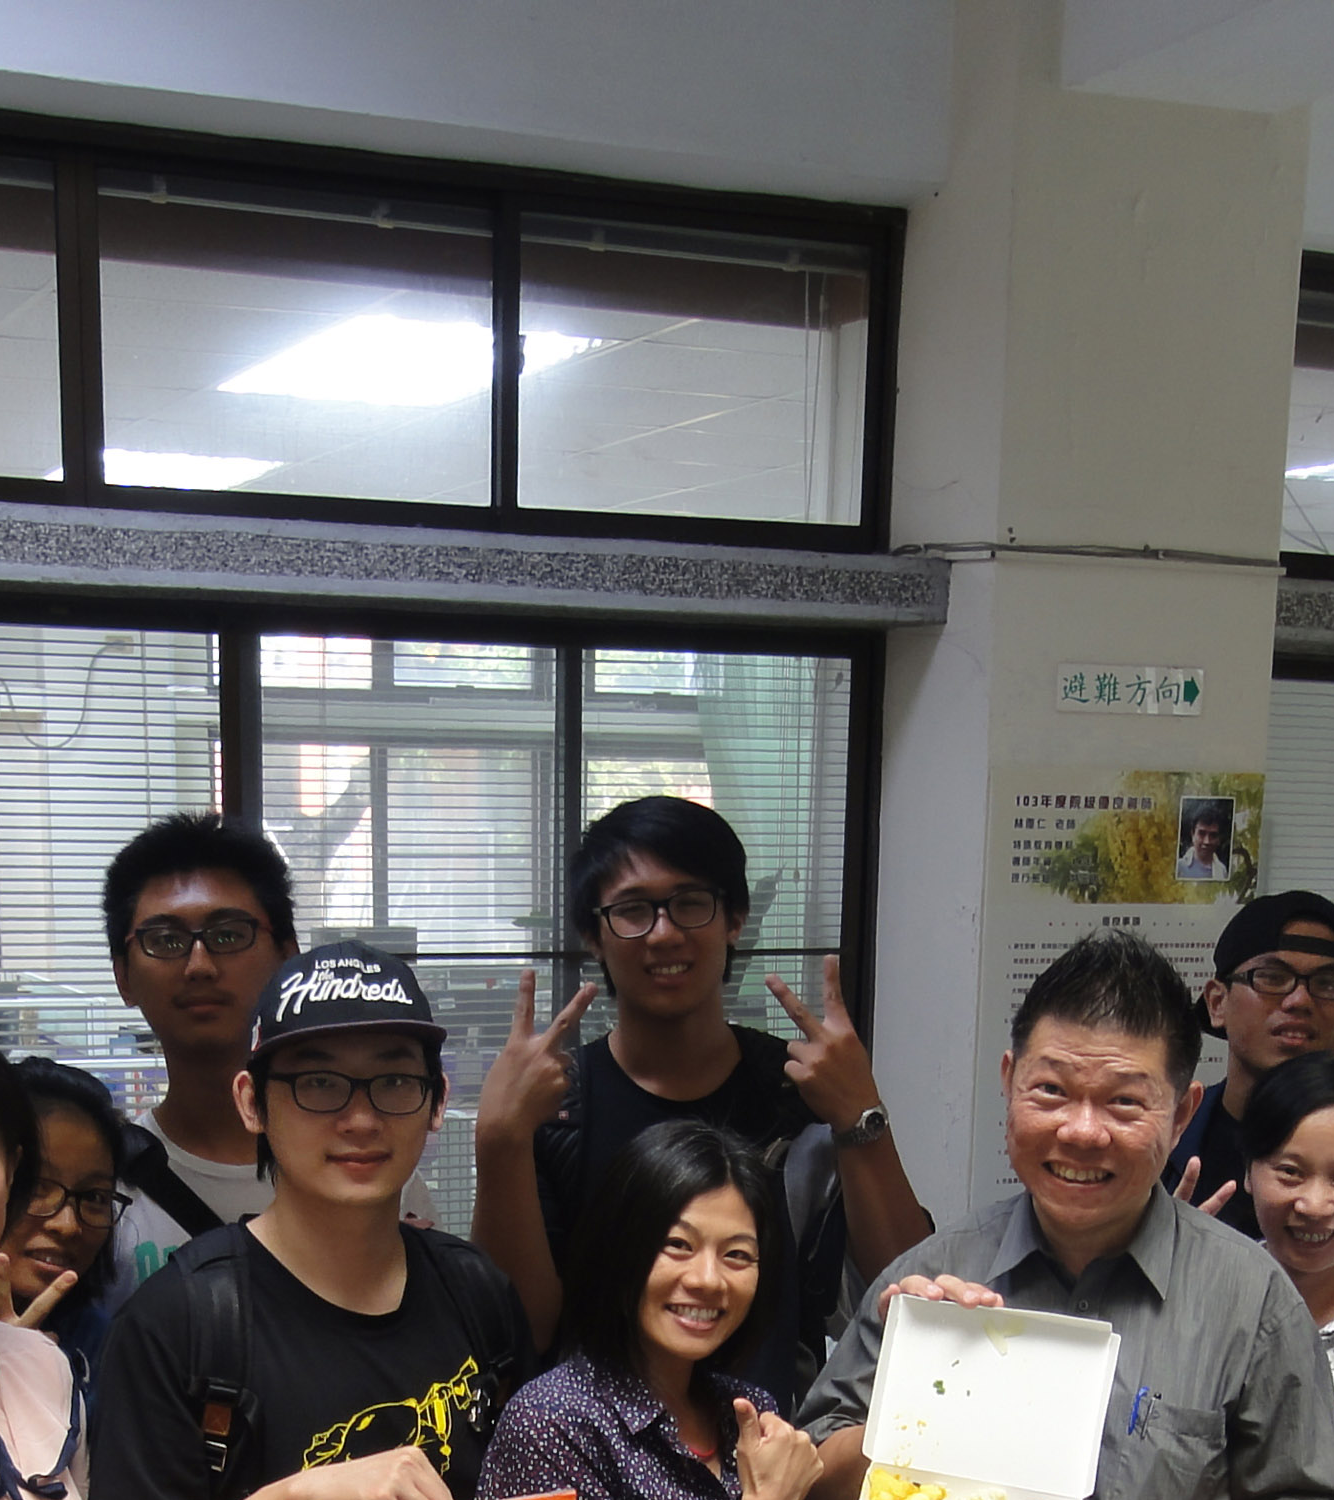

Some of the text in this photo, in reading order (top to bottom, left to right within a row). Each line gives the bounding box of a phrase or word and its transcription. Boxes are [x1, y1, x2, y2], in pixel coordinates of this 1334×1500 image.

[1061, 671, 1182, 706] 避難方向
[315, 958, 381, 973] LOS ANGLES
[276, 971, 413, 1023] Hundreds
